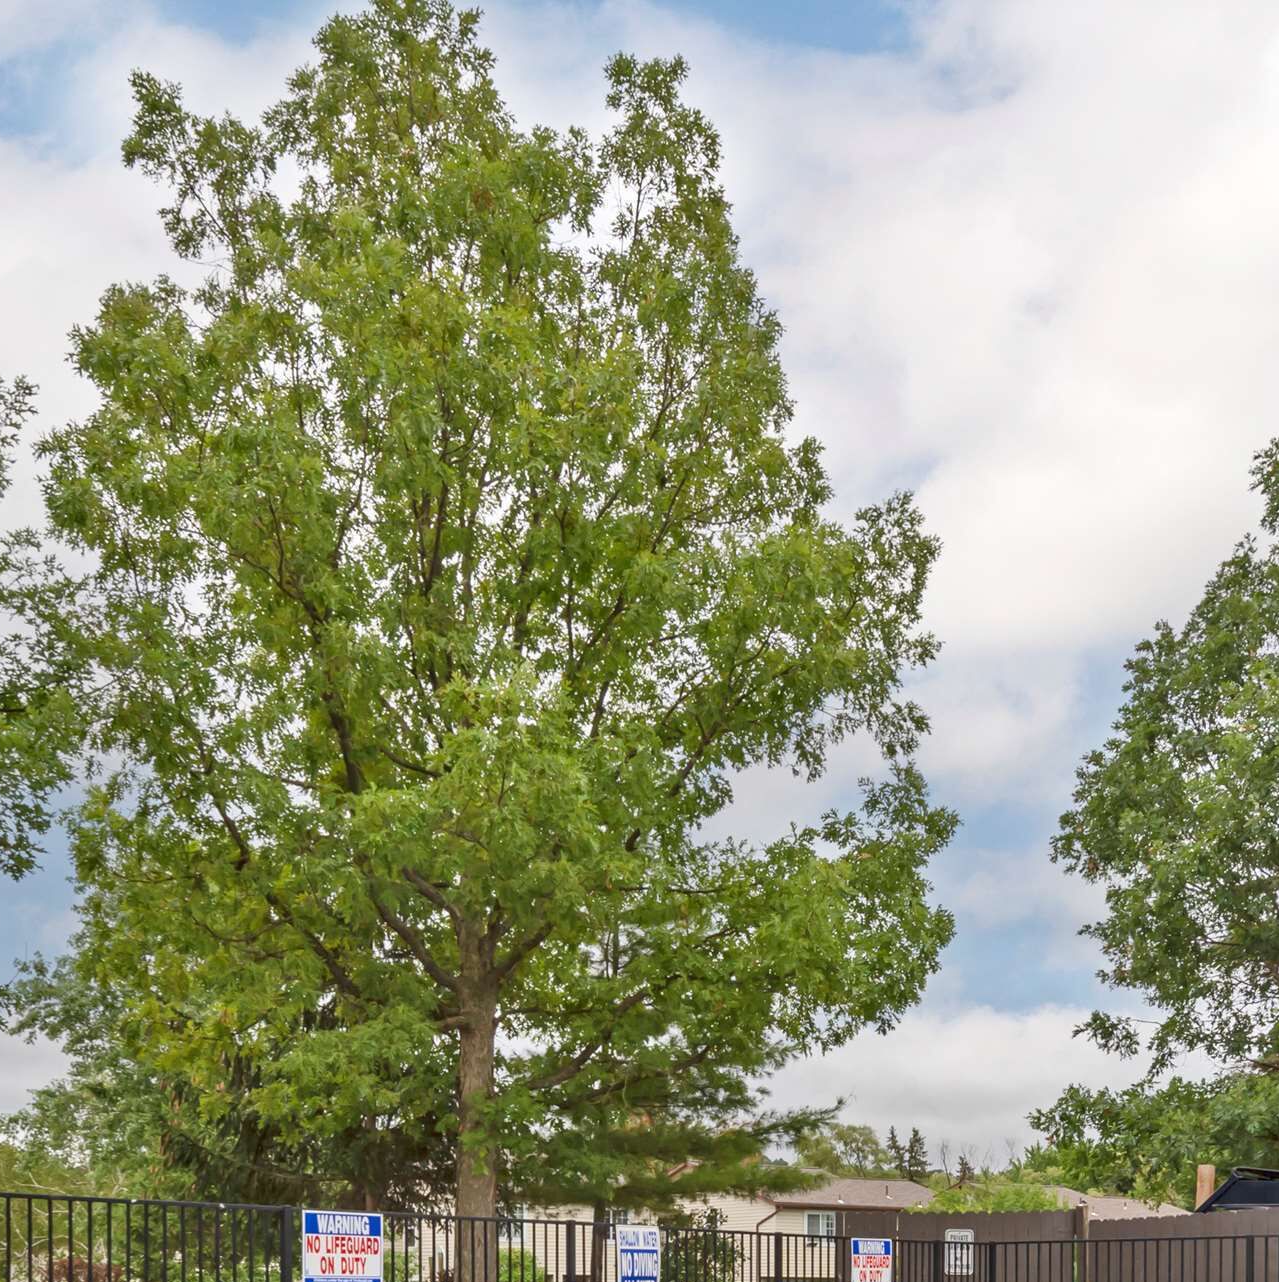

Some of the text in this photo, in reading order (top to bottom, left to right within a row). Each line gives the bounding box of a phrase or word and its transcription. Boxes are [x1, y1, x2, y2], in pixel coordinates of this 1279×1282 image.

[317, 1213, 370, 1235] WARNING
[306, 1235, 380, 1255] NO LIFEGUARD
[320, 1256, 367, 1275] ON DUTY
[621, 1252, 658, 1277] NO DIVING
[853, 1256, 890, 1269] NO LIFEGUARD
[859, 1271, 883, 1282] ON DUTY
